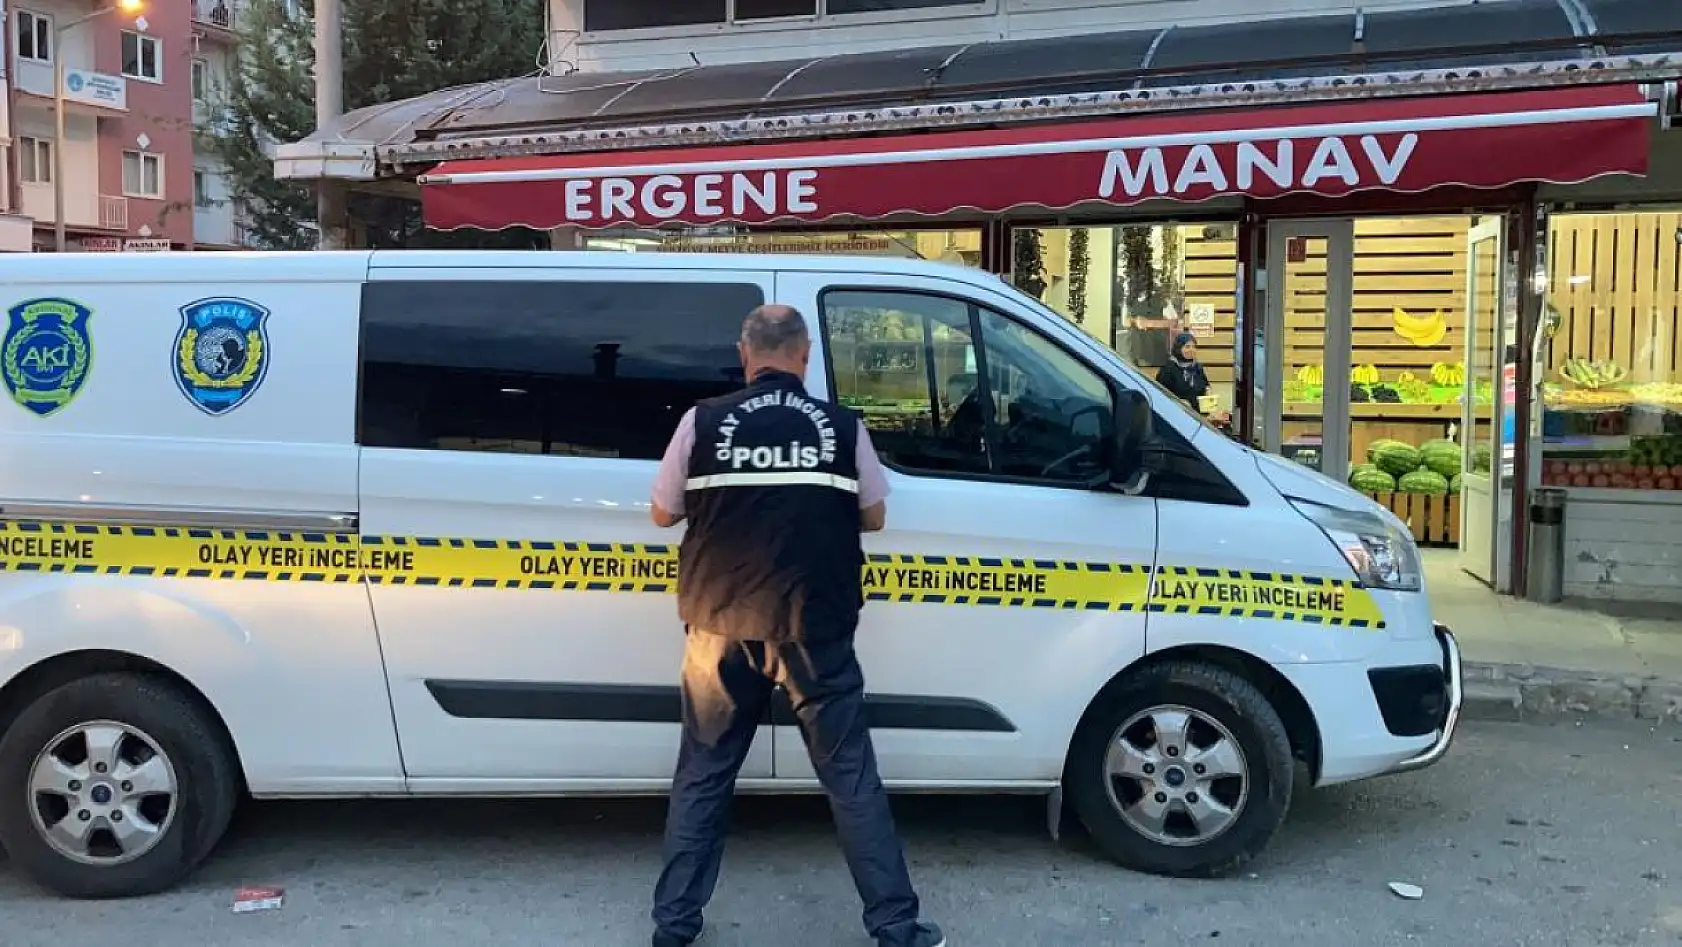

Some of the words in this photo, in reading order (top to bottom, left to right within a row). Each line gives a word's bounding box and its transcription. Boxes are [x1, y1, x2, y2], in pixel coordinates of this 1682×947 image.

[564, 170, 818, 220] ERGENE
[1099, 133, 1418, 197] MANAV
[714, 413, 740, 461] OLAY
[738, 389, 782, 413] YERİ
[784, 392, 837, 463] İNCELEME
[732, 441, 818, 469] POLİS
[199, 543, 252, 565] OLAY
[520, 555, 574, 575] OLAY
